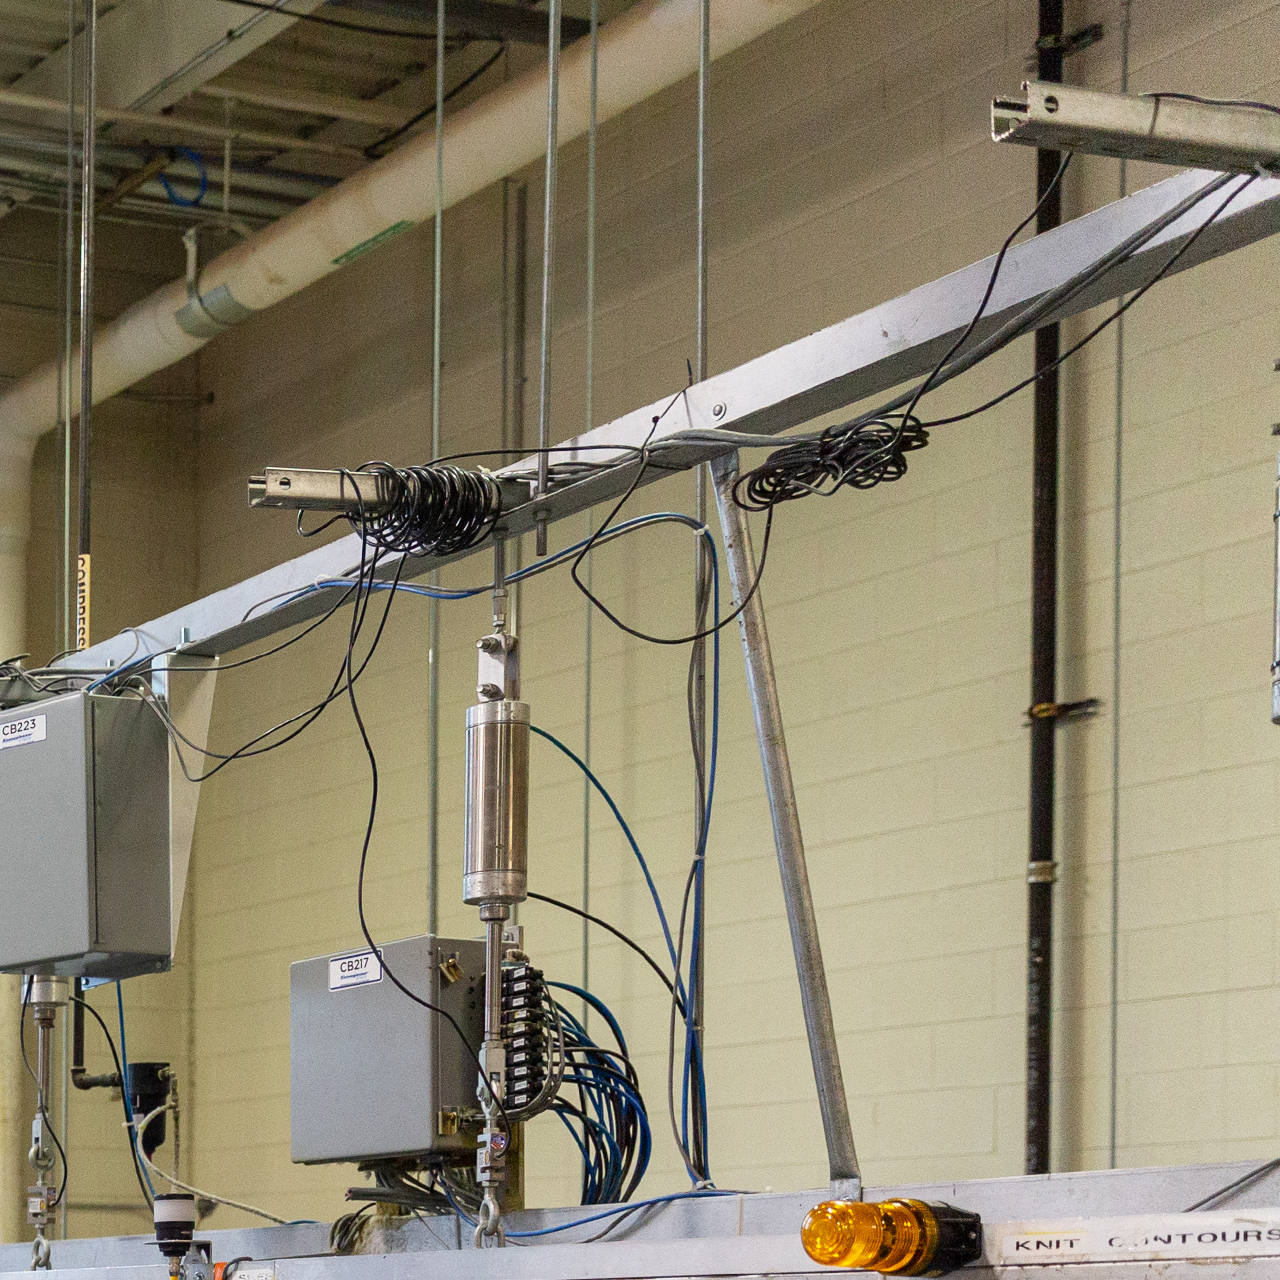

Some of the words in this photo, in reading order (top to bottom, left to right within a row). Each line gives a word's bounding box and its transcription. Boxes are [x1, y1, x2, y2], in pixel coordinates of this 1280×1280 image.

[2, 718, 37, 736] CB223
[340, 956, 369, 973] CB217
[1015, 1238, 1081, 1251] KNIT
